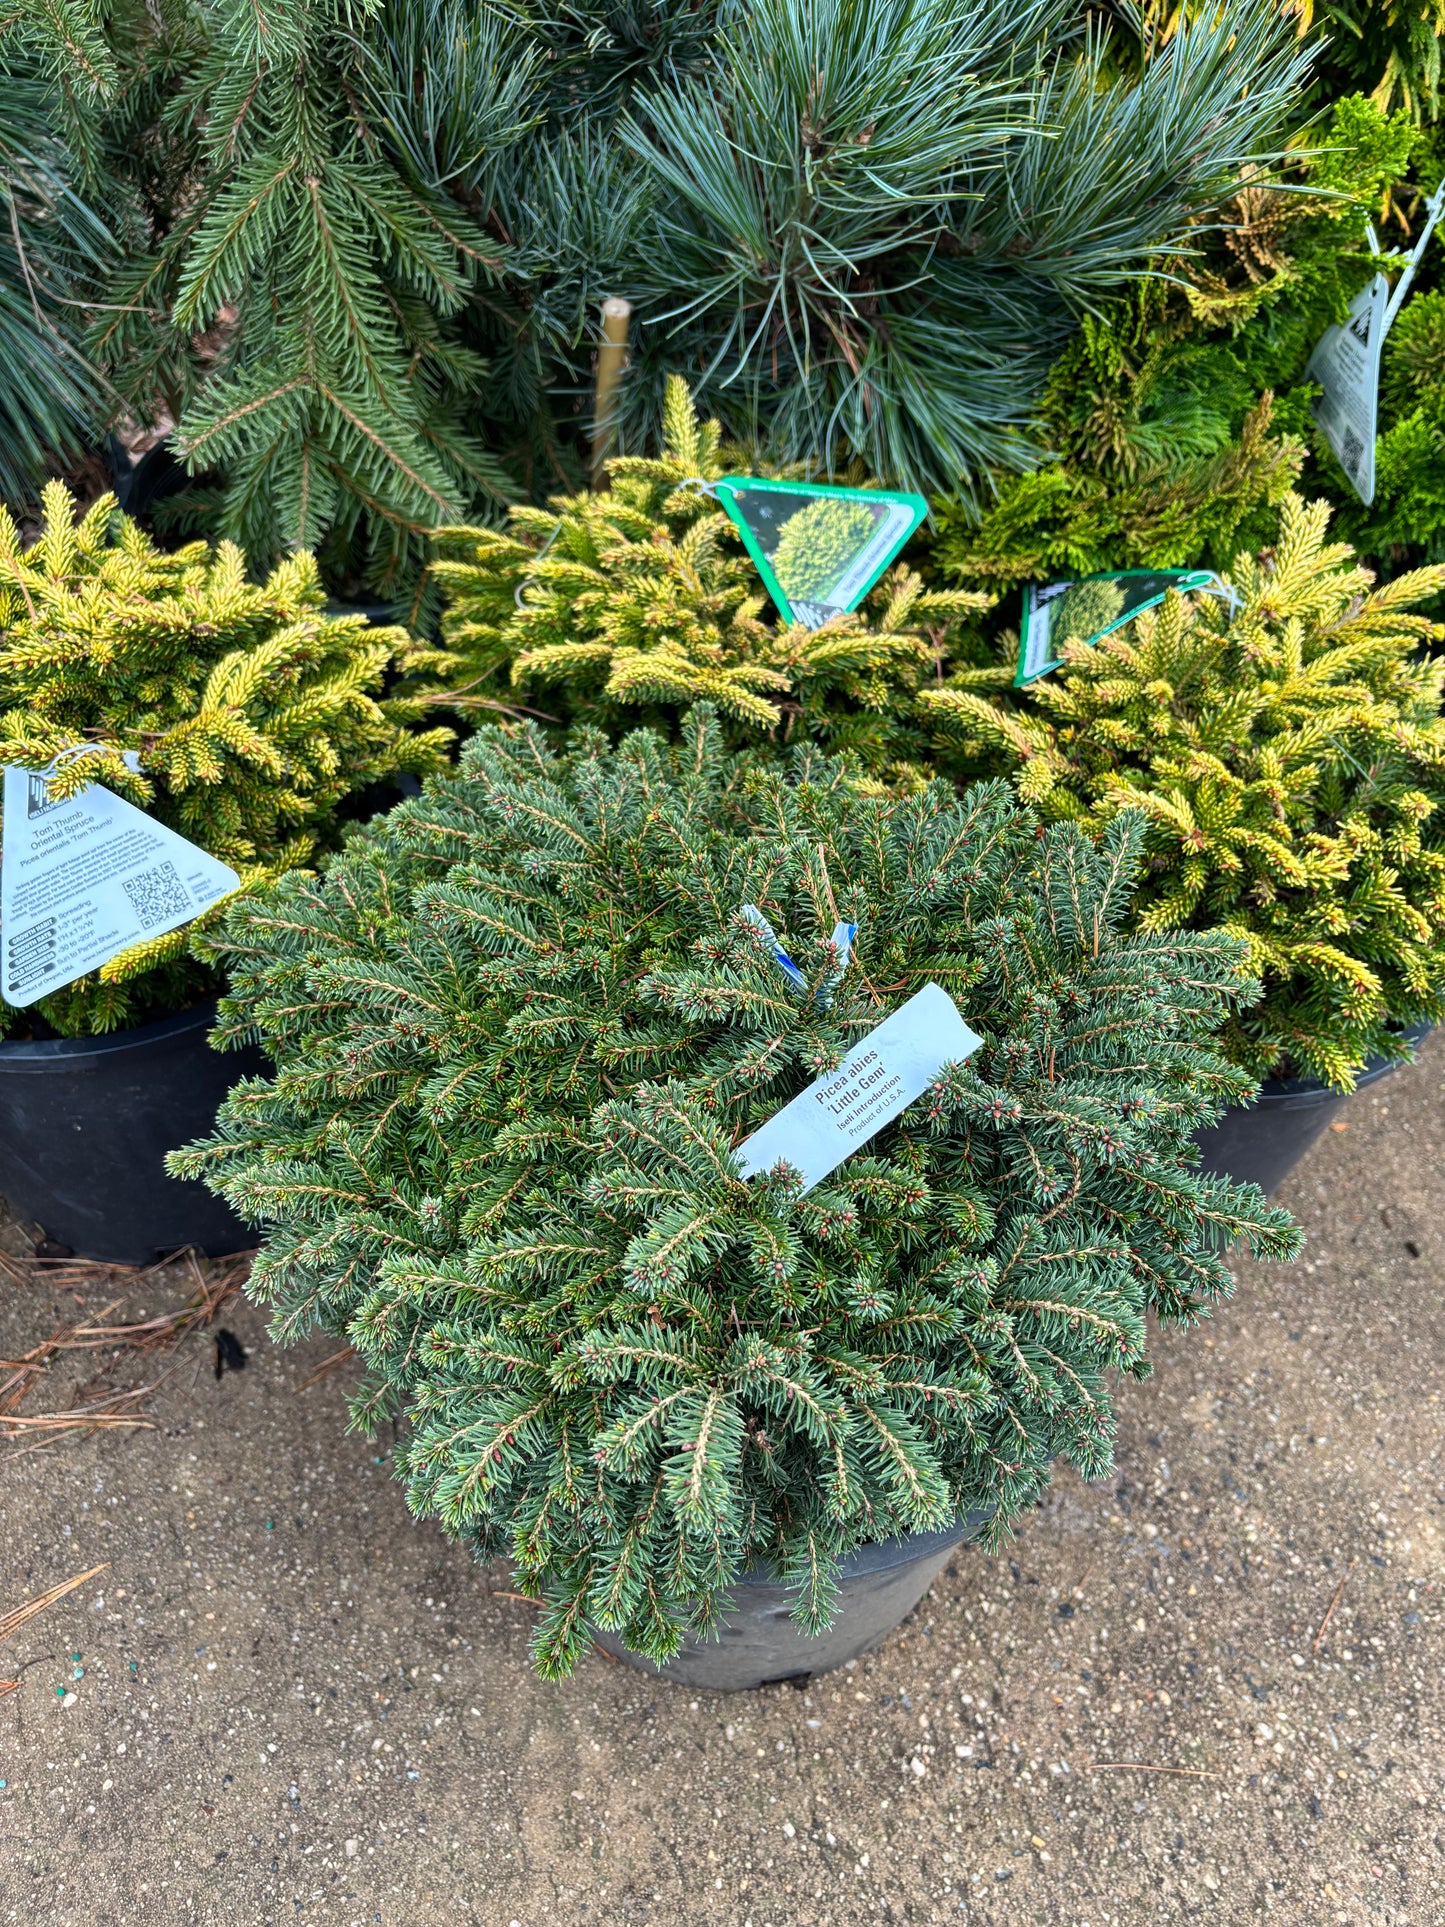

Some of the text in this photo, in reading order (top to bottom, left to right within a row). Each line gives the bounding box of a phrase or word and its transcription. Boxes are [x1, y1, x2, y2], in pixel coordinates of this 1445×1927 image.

[30, 815, 94, 850] Oriental Spruce
[31, 810, 83, 838] Tom Thumb
[19, 854, 39, 867] Picea
[39, 839, 70, 857] orientalis
[11, 927, 37, 944] GROWTH
[35, 918, 53, 931] HABIT
[57, 899, 91, 919] Spreading
[12, 938, 38, 955] GROWTH
[71, 914, 82, 924] per
[83, 906, 98, 918] year
[8, 967, 24, 979] COLD
[23, 951, 54, 971] HARDINESS
[17, 967, 46, 986] SUNLIGHT
[56, 955, 70, 964] Sun
[17, 984, 37, 997] Product
[62, 964, 74, 973] USA
[814, 1050, 878, 1104] Picea abies
[836, 1075, 901, 1130] Iseli Introduction
[848, 1088, 906, 1136] Product of U.S.A.
